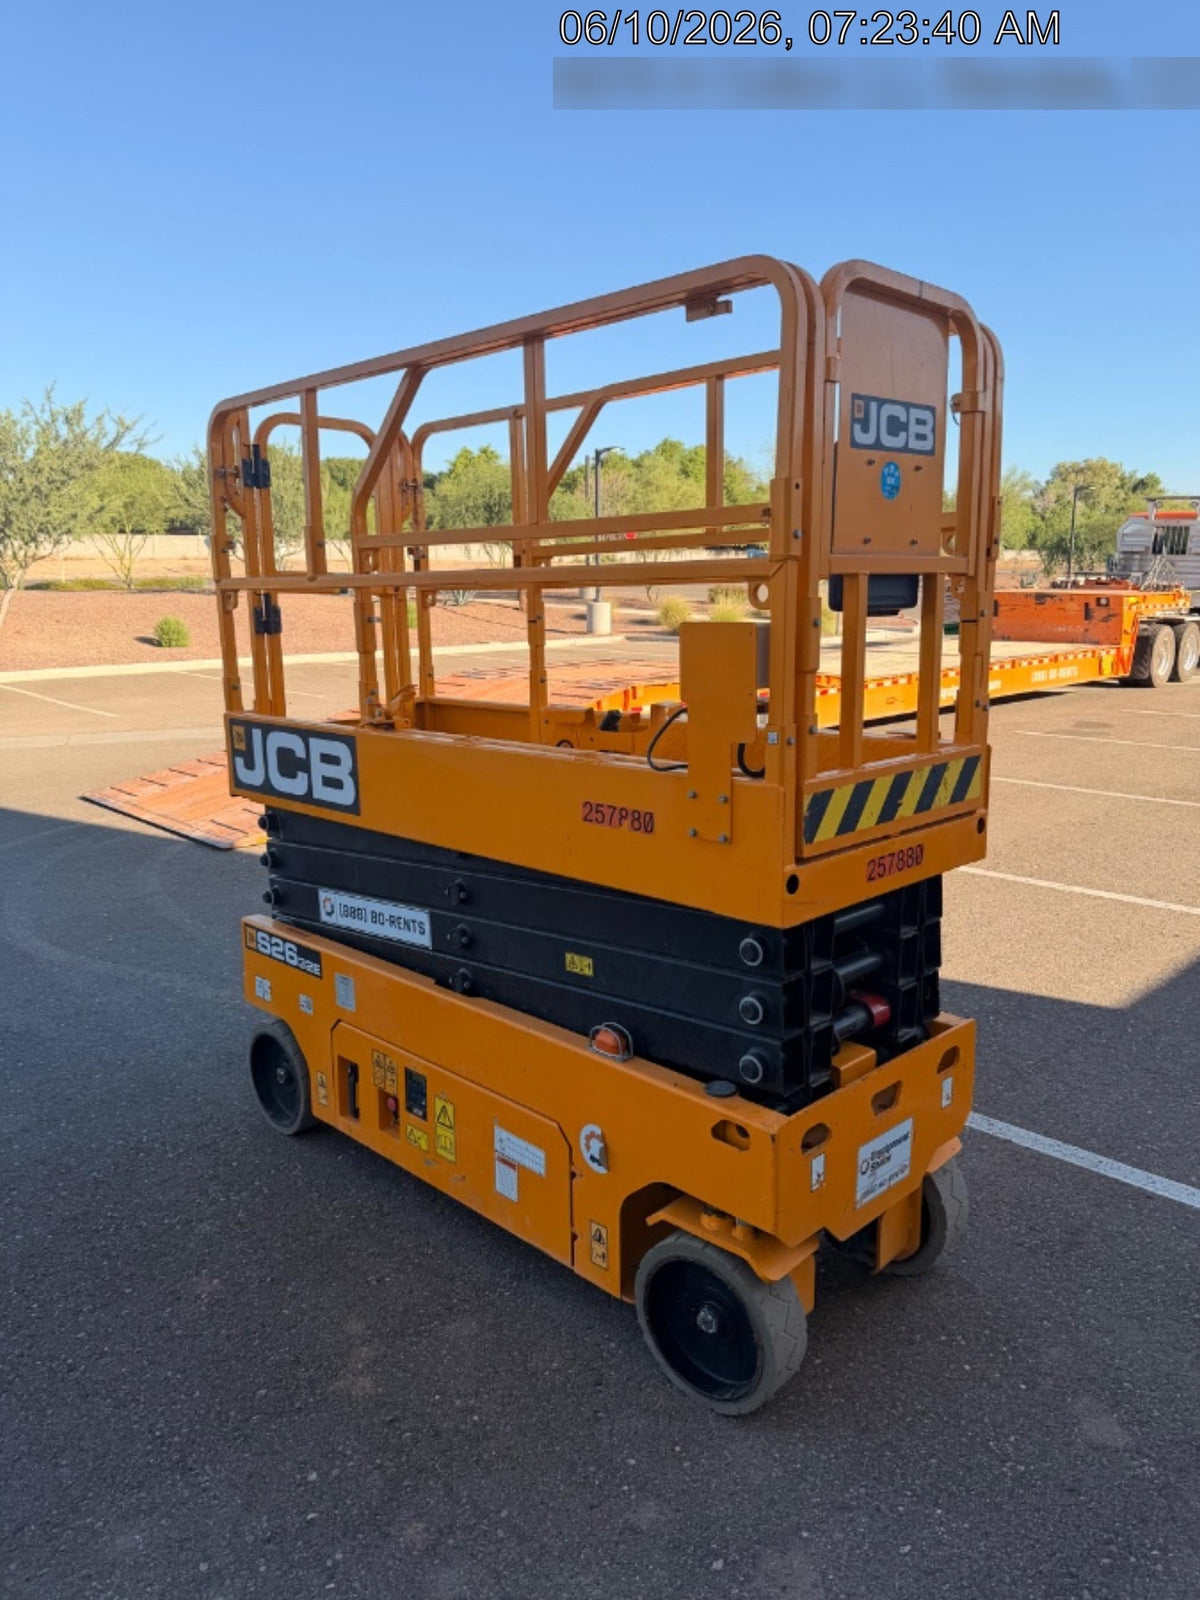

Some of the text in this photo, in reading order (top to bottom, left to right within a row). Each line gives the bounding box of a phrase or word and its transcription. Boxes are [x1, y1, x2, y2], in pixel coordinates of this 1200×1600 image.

[853, 401, 934, 451] JCB
[234, 728, 356, 806] JCB
[866, 844, 924, 882] 257880
[339, 902, 367, 924] (888)
